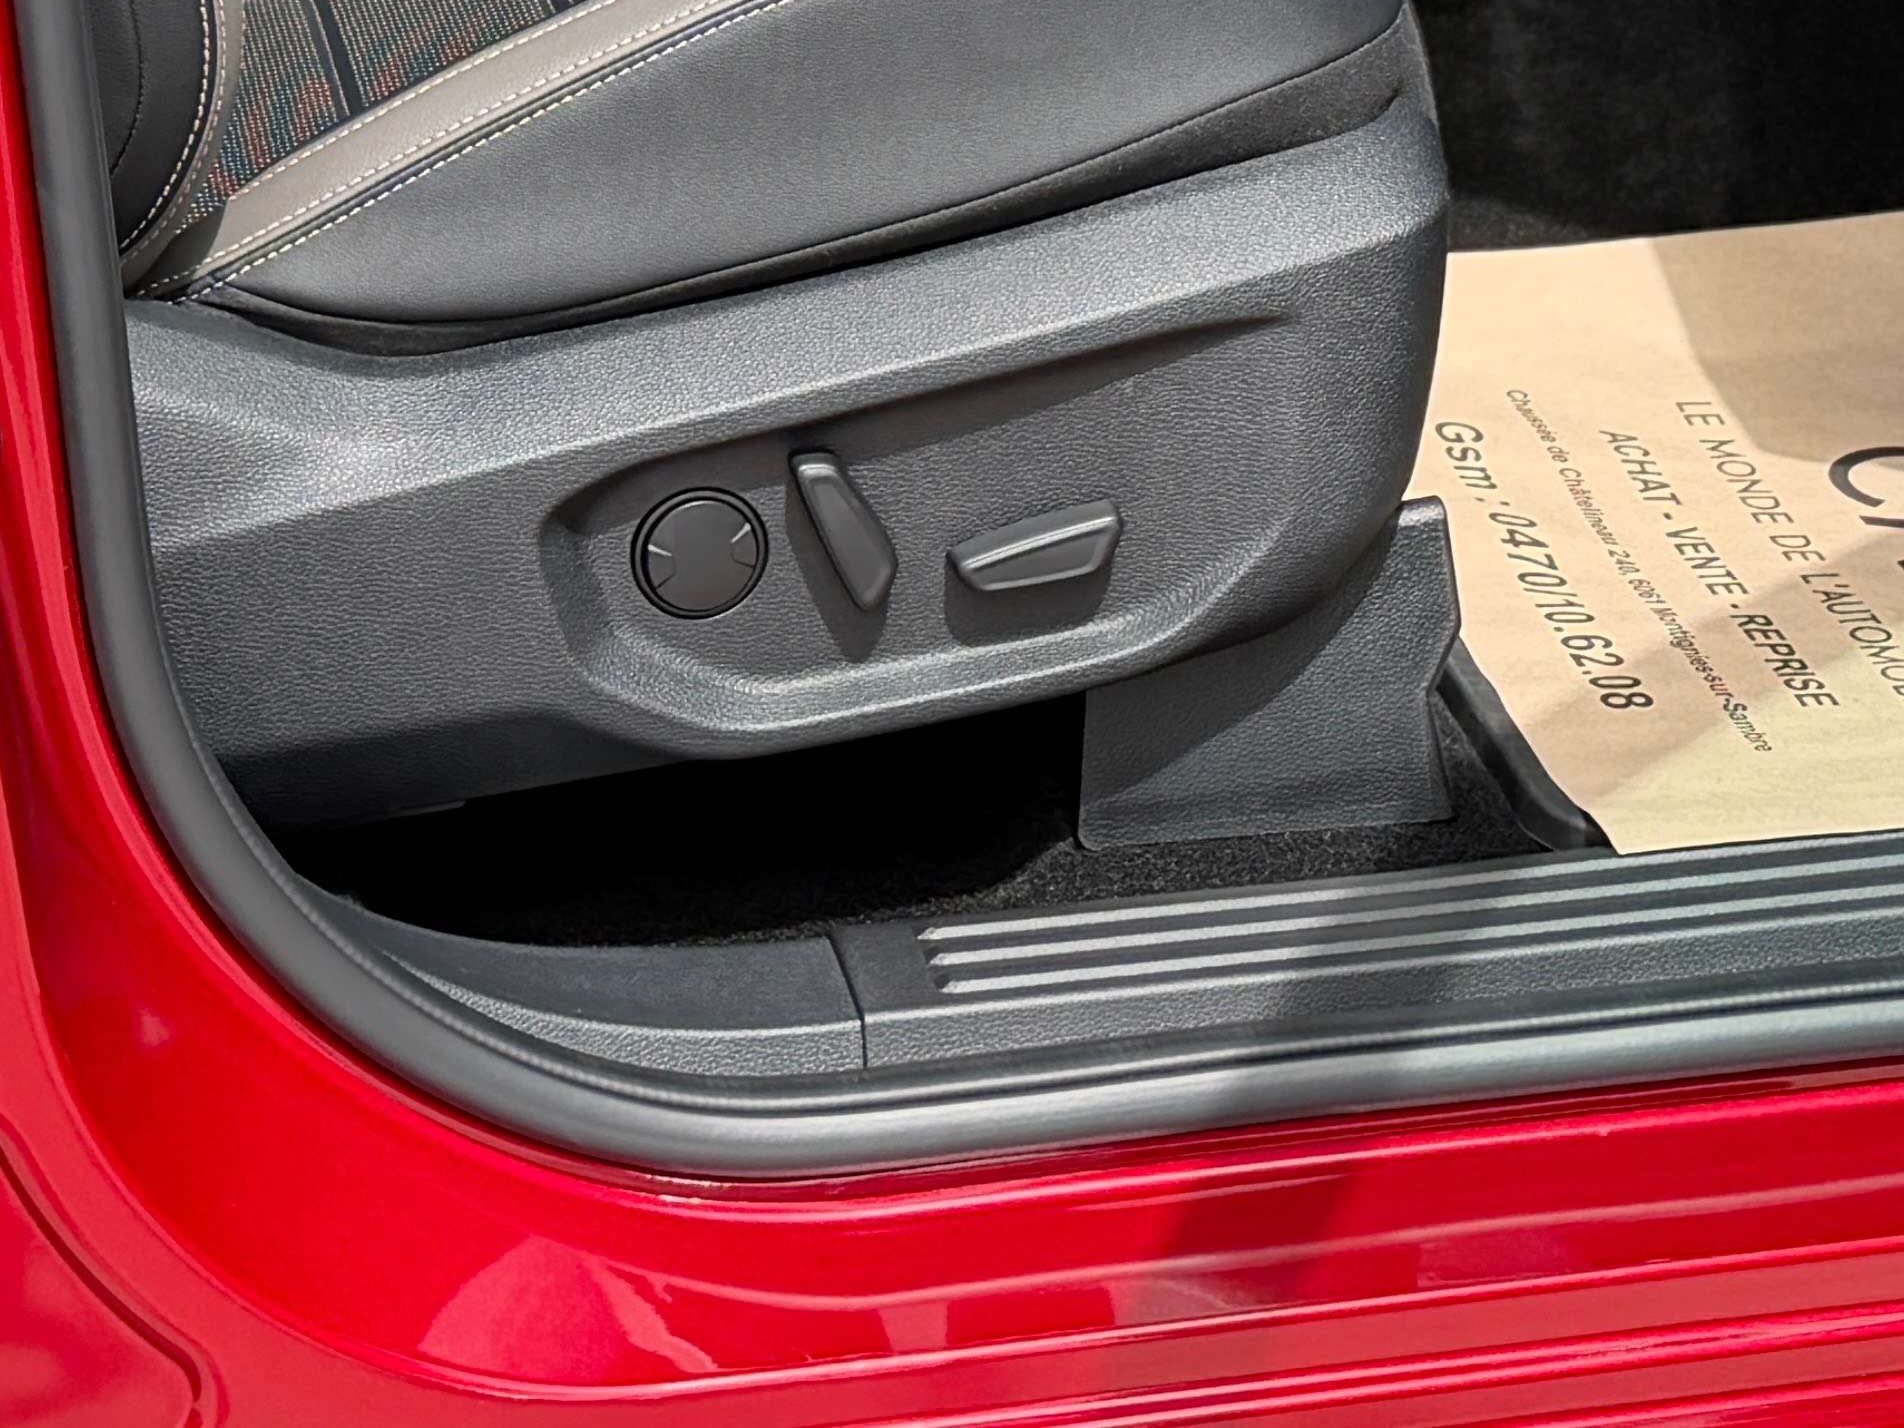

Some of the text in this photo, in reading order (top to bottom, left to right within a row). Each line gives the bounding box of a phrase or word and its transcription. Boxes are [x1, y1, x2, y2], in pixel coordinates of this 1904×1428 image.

[1675, 400, 1726, 427] LE
[1546, 445, 1571, 464] de
[1698, 438, 1795, 525] MONDE
[1434, 419, 1498, 491] Gsm
[1487, 510, 1656, 711] 0470/10.62.08
[1598, 428, 1684, 508] ACHAT
[1664, 525, 1751, 597] VENTE
[1729, 612, 1841, 708] REPRISE
[1768, 533, 1826, 562] DE
